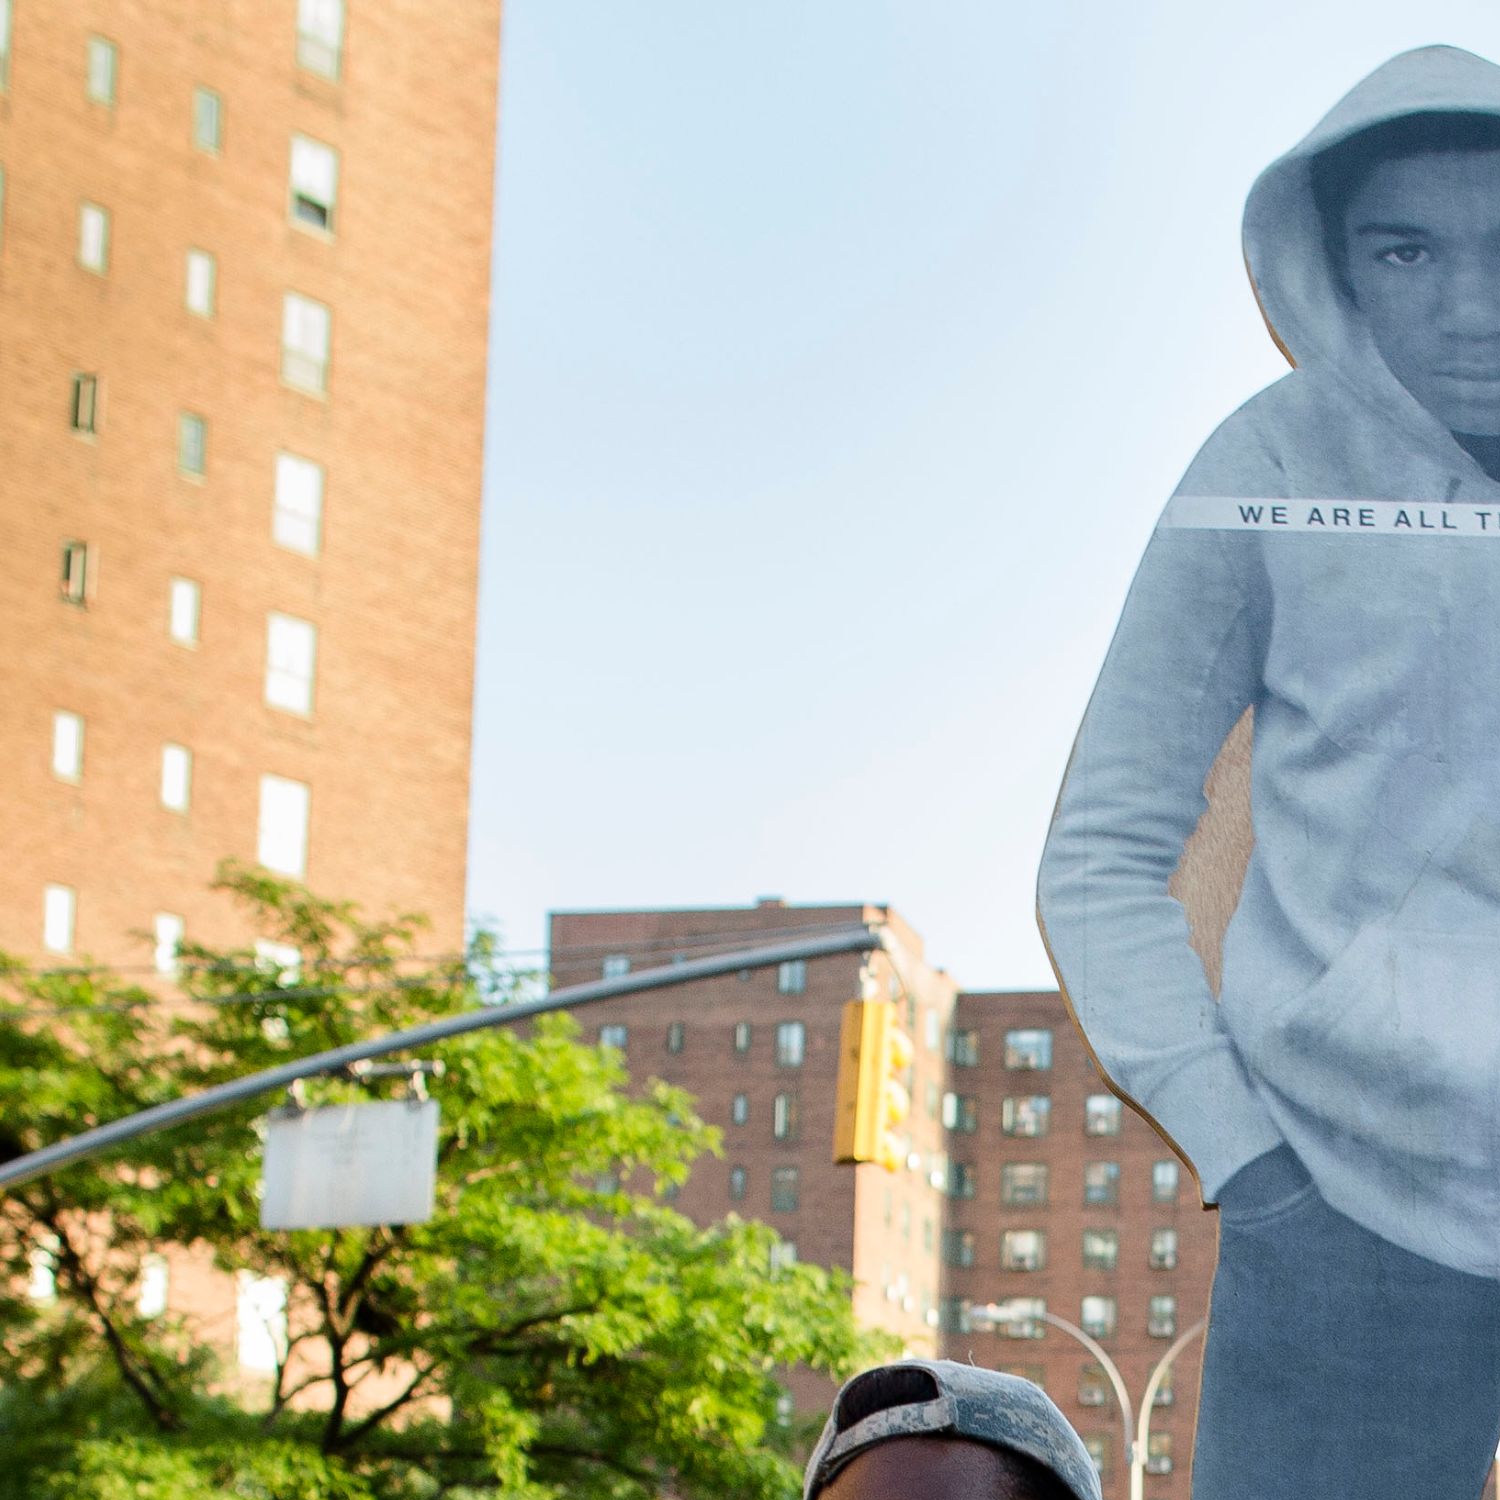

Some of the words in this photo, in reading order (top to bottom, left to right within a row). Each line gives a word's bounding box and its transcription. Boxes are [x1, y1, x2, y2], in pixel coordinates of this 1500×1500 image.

[1238, 505, 1289, 524] WE
[1307, 507, 1376, 527] ARE
[1394, 510, 1458, 529] ALL
